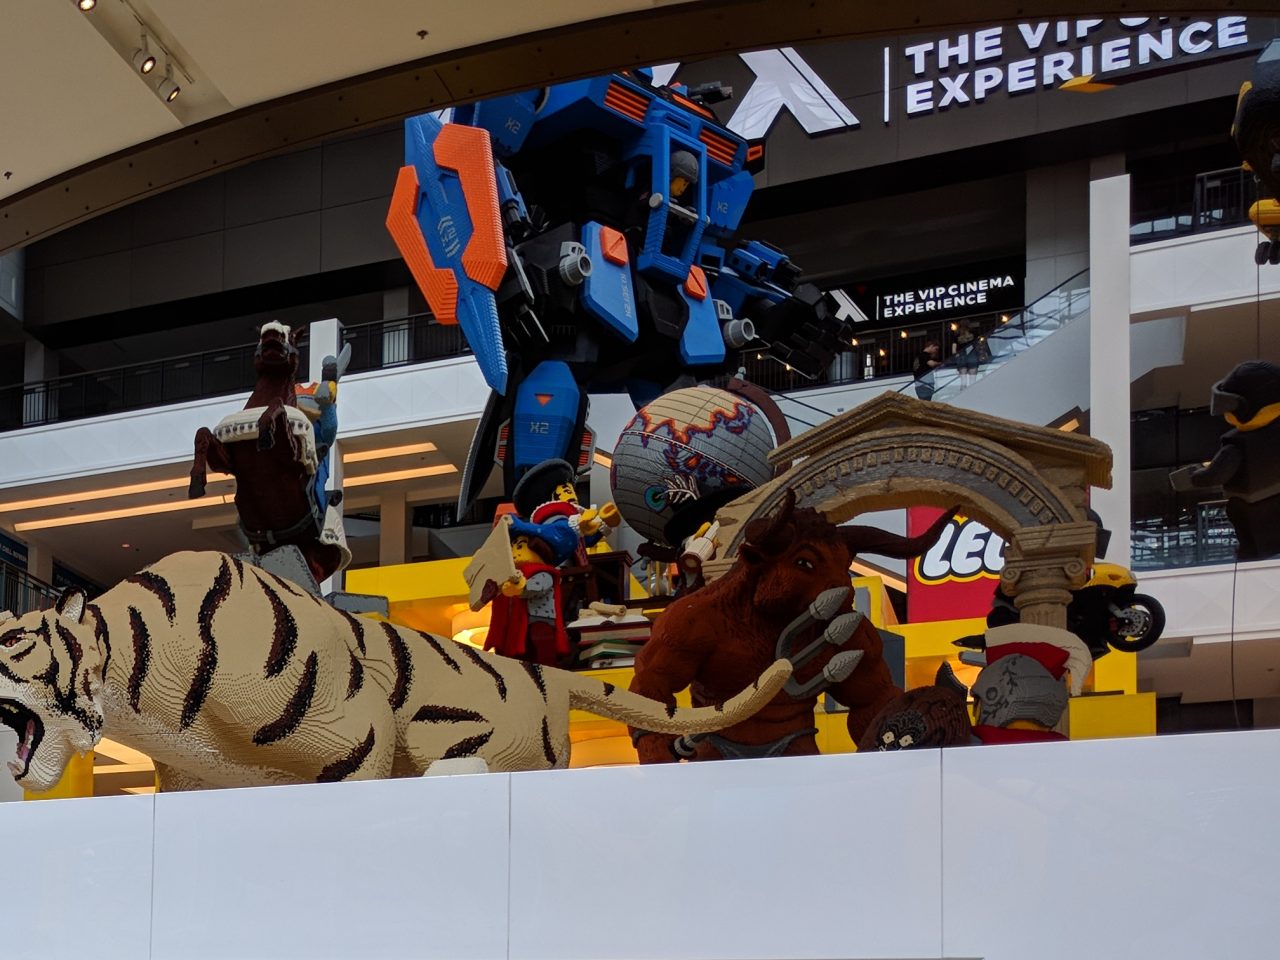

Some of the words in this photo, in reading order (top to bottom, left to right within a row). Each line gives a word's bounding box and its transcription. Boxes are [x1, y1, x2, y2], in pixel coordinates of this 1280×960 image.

[905, 26, 1003, 75] THE
[1018, 19, 1104, 50] VIP
[907, 16, 1248, 114] EXPERIENCE
[883, 291, 915, 306] THE
[918, 286, 946, 300] VIP
[947, 275, 1015, 296] CINEMA
[883, 292, 987, 318] EXPERIENCE
[529, 421, 549, 434] X2
[922, 520, 1011, 577] LE
